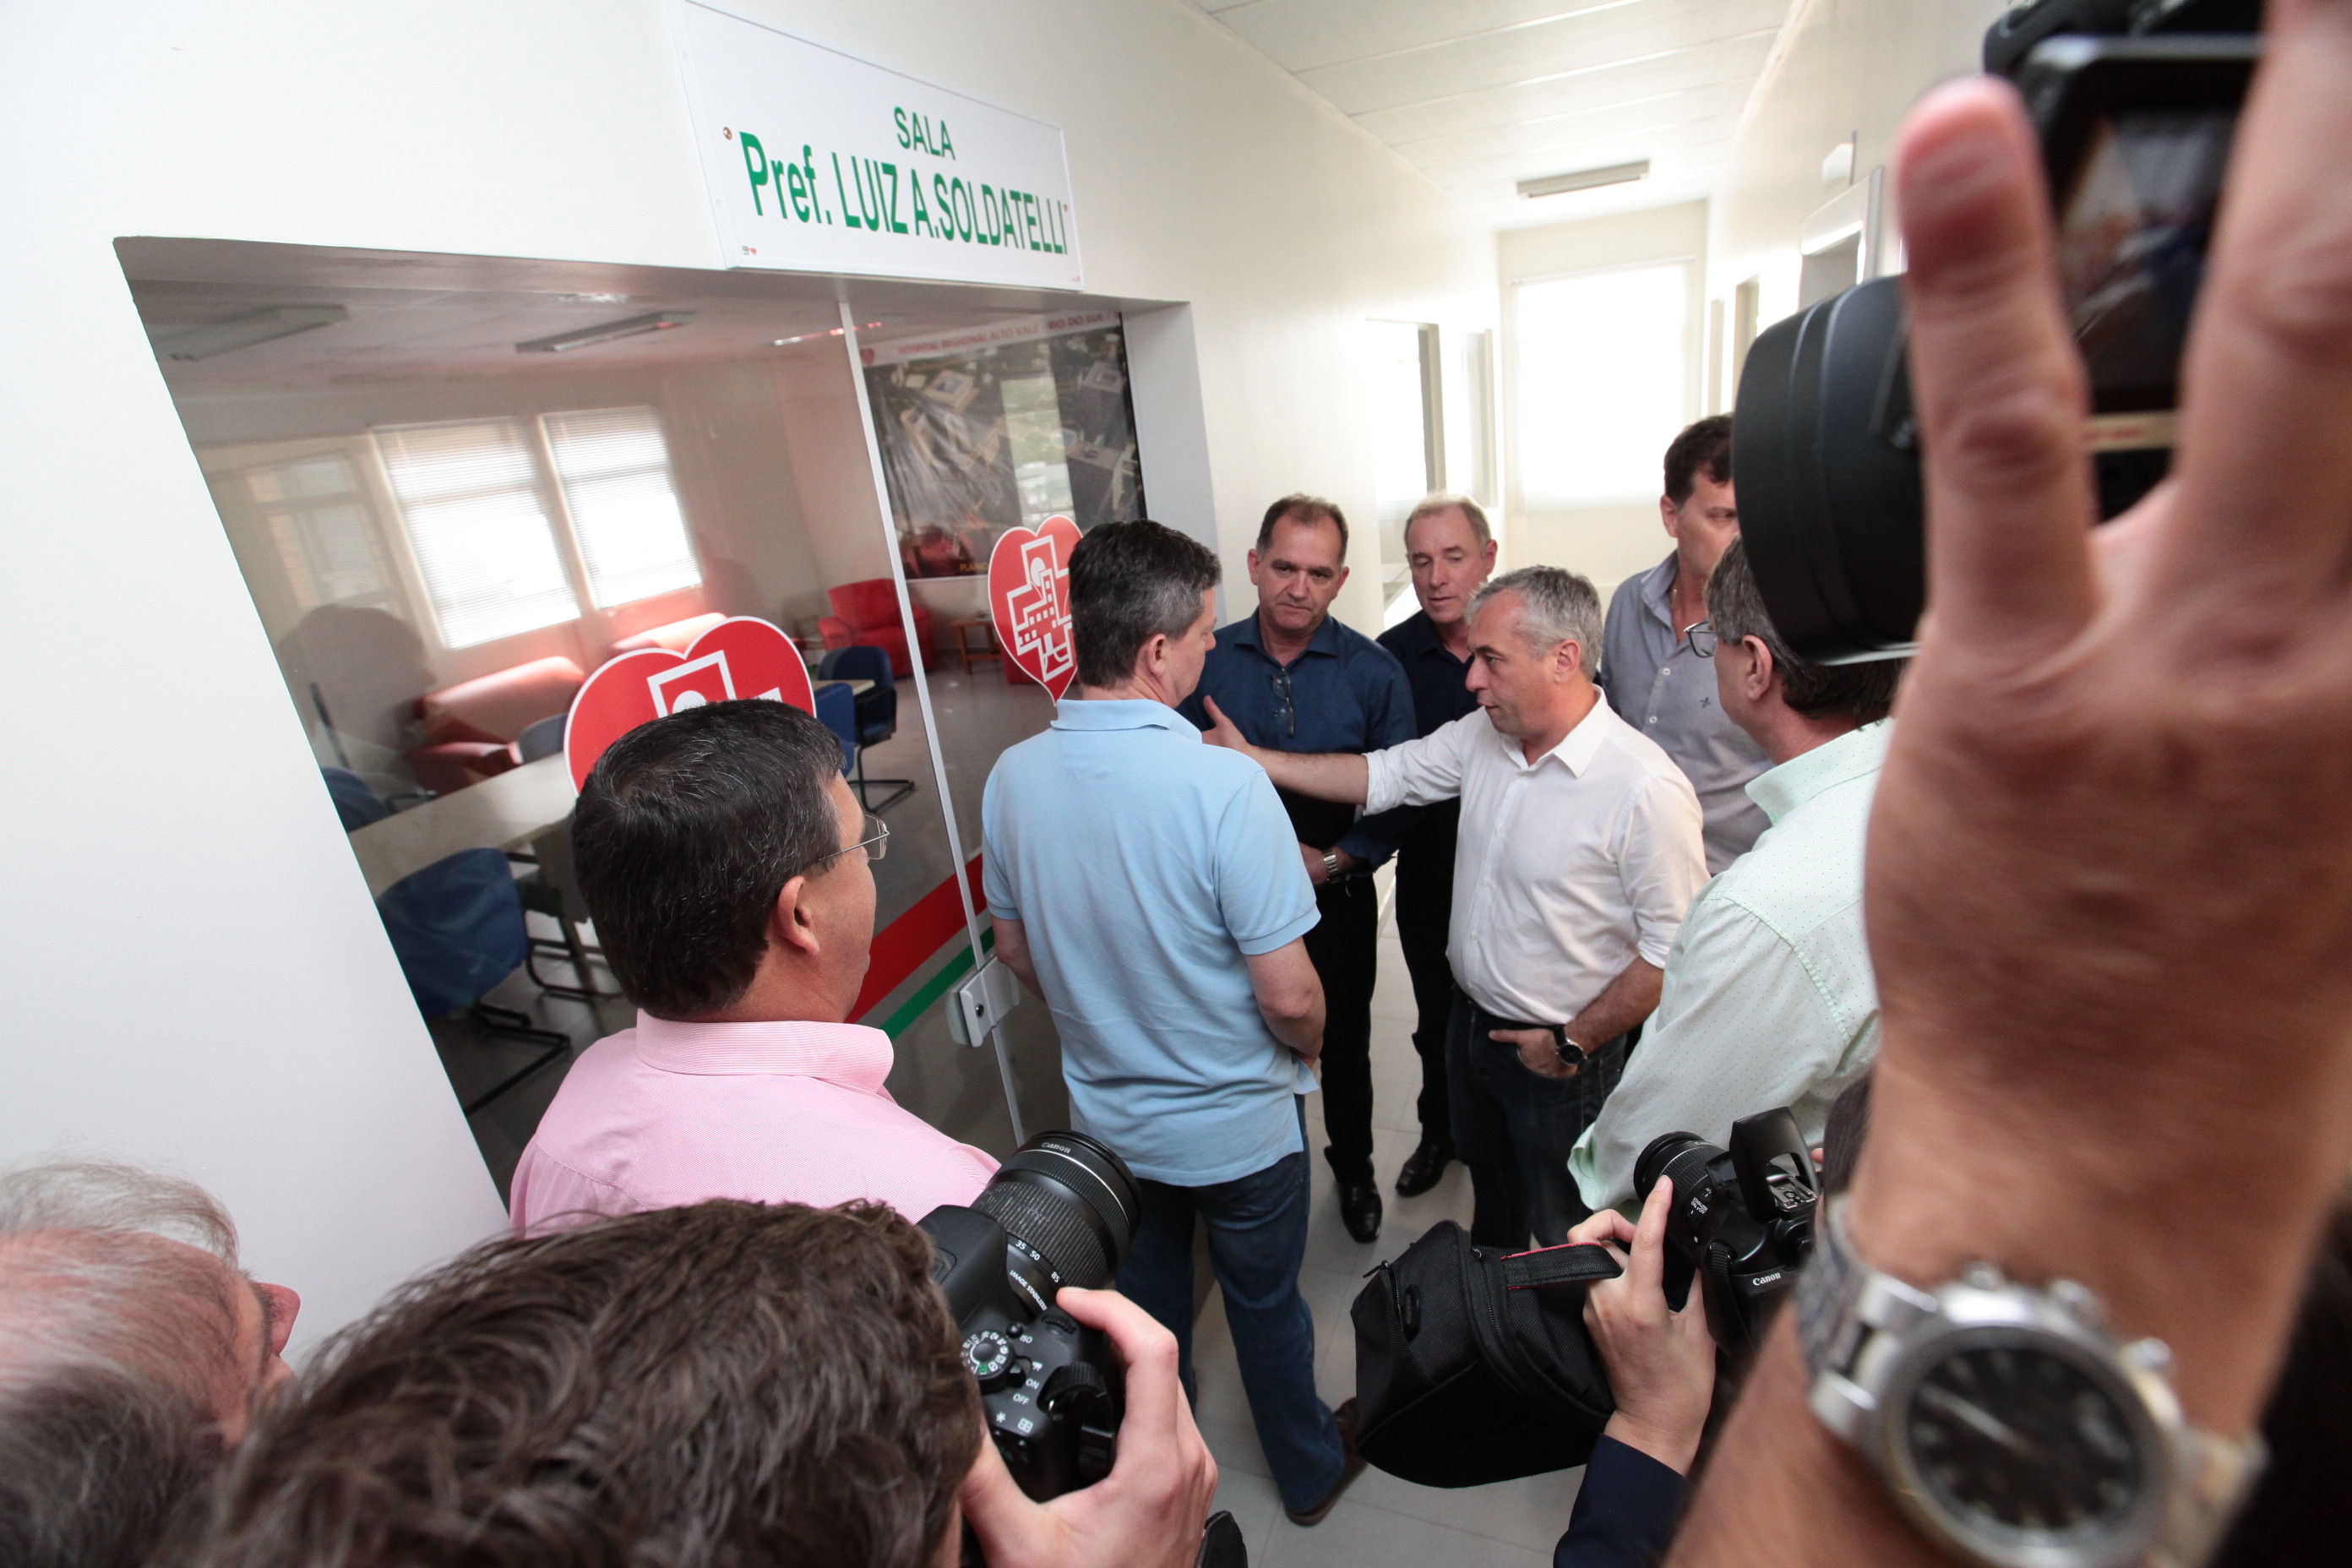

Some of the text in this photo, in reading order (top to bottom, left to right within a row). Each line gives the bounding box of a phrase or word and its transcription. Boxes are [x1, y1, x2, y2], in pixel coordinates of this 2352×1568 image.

[894, 106, 956, 161] SALA
[739, 130, 833, 226] Pref.
[831, 151, 909, 234] LUIZ
[1041, 1141, 1071, 1154] Canon
[1015, 1240, 1060, 1283] 35 50 85
[1009, 1270, 1028, 1288] IMAGE
[1752, 1271, 1782, 1287] Canon
[1020, 1334, 1032, 1344] ISO
[1026, 1377, 1040, 1390] ON
[1012, 1392, 1030, 1405] OFF
